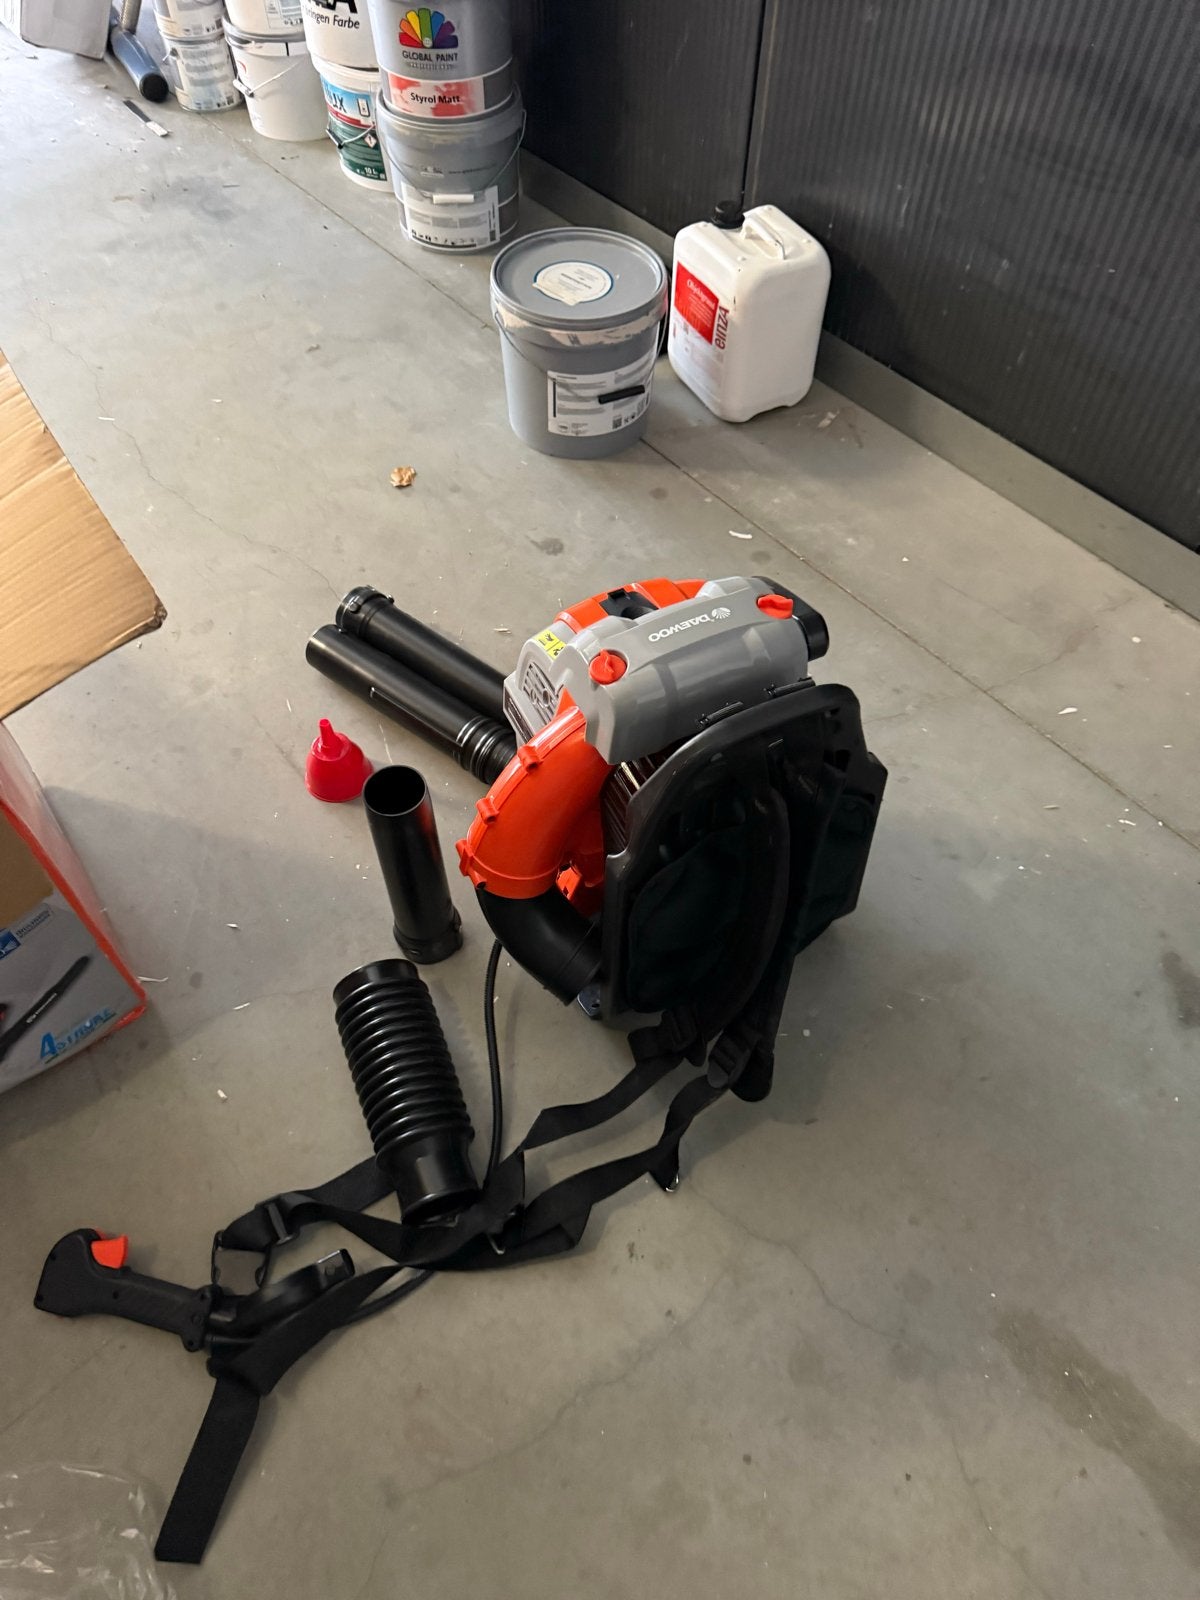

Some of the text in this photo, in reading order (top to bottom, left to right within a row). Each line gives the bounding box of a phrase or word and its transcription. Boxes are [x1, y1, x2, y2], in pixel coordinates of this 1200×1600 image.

[333, 15, 360, 29] Farbe
[402, 51, 458, 62] GLOBAL PAINT
[411, 92, 461, 104] Styrol Matt
[648, 613, 711, 642] DAEWOO
